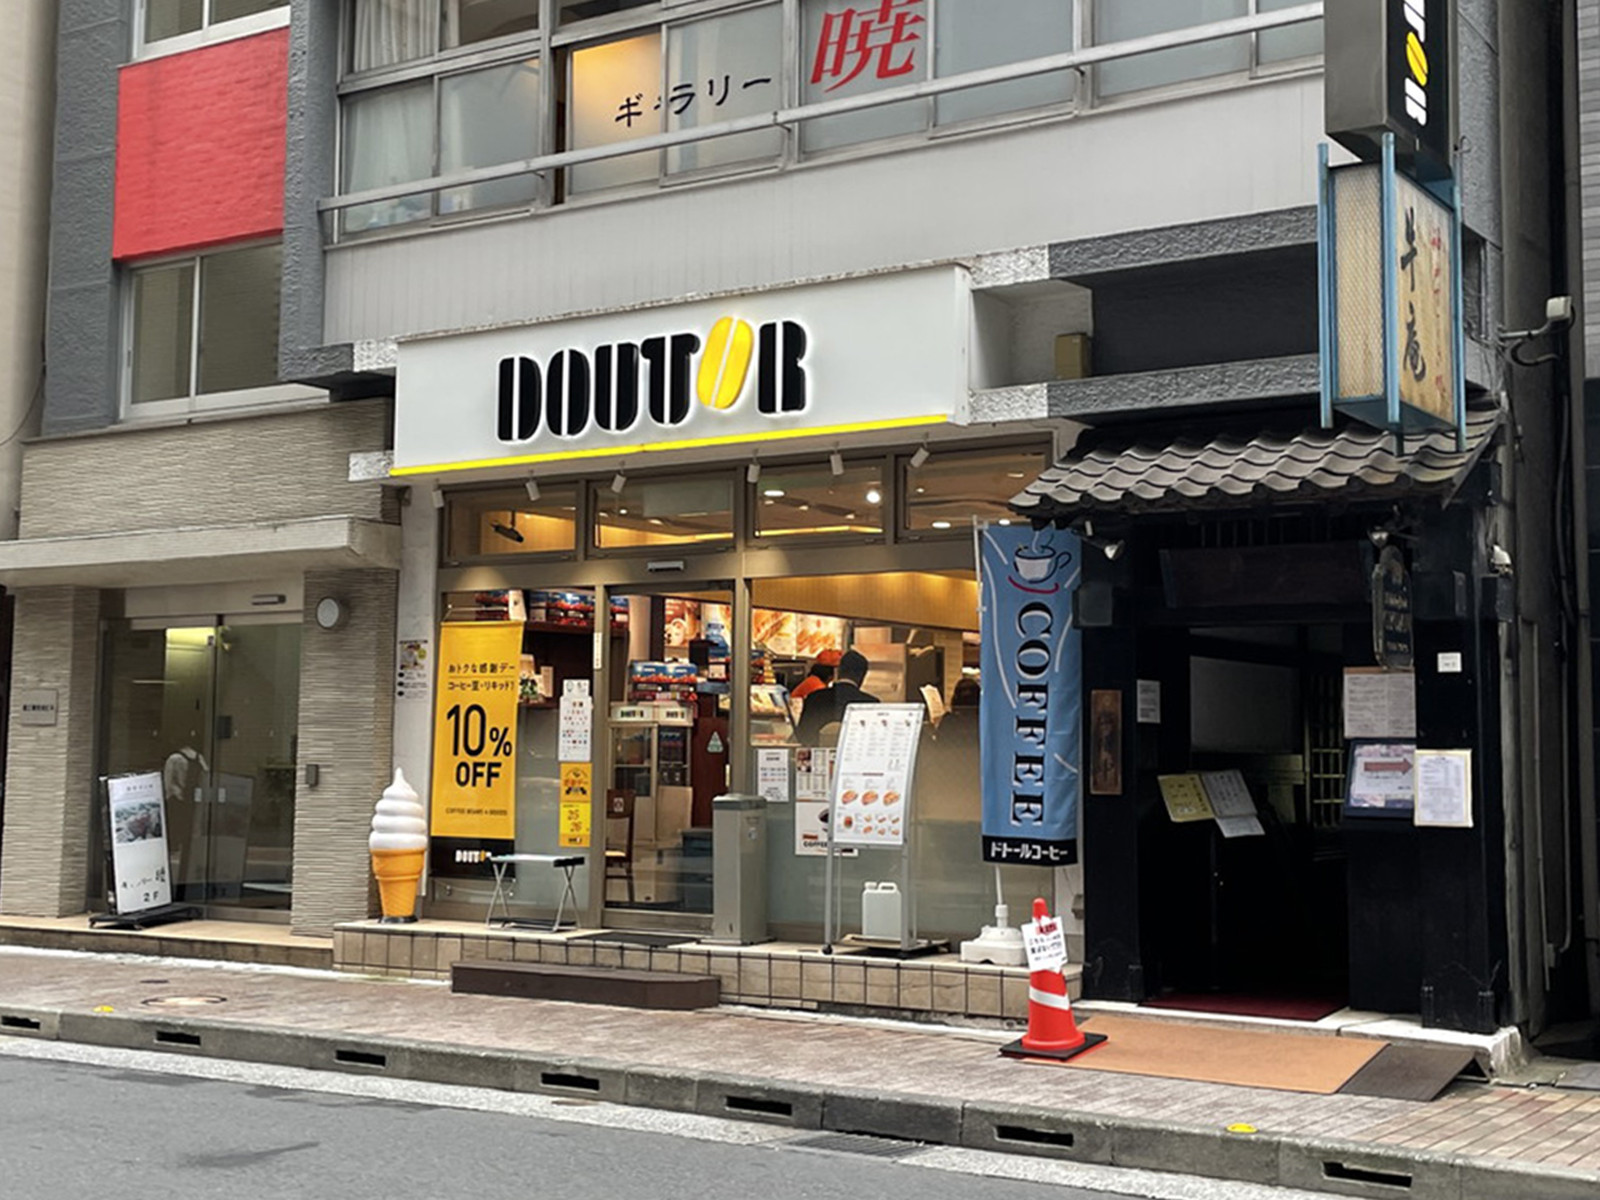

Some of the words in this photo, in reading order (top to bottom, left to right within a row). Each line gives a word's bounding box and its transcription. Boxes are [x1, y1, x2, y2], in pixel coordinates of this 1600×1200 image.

[497, 315, 807, 442] DOUTOR
[446, 703, 513, 757] 10%
[1011, 601, 1052, 826] COFFEE
[455, 761, 502, 788] OFF
[990, 841, 1069, 861] ドトールコーヒー
